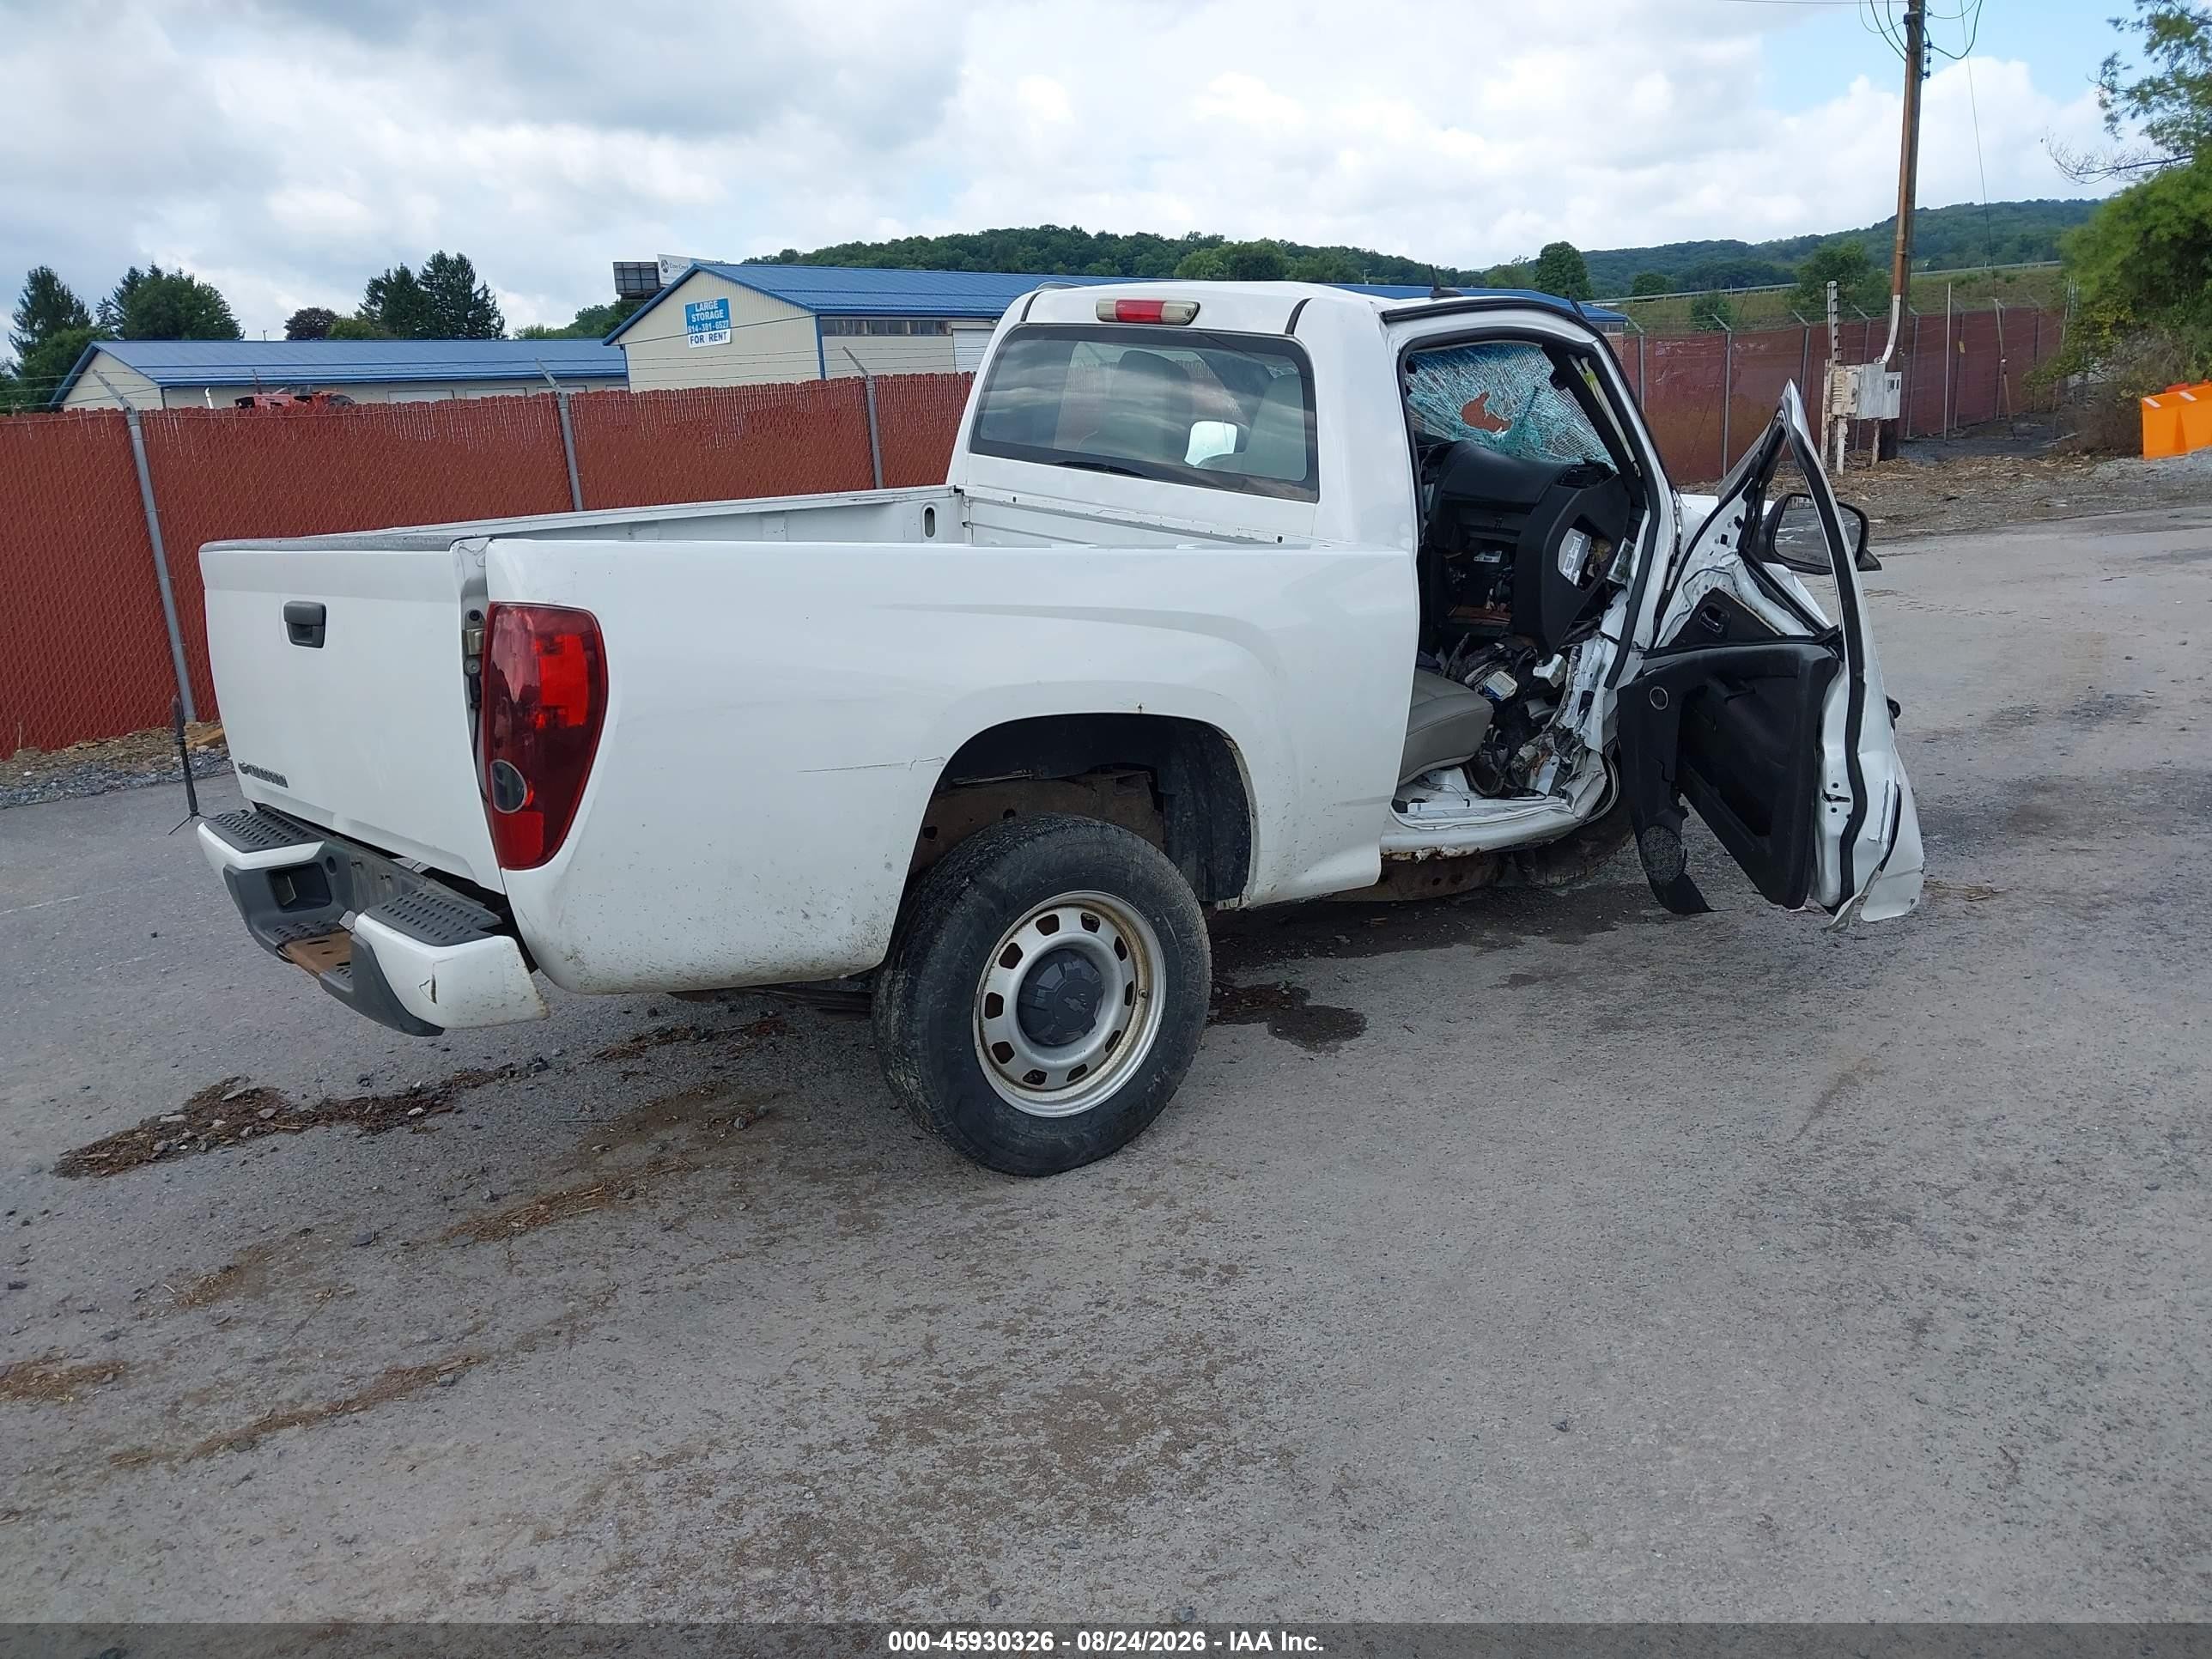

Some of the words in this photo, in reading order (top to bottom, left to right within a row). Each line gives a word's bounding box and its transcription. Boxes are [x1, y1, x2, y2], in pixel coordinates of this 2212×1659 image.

[695, 301, 719, 313] LARGE
[691, 309, 724, 323] STORAGE
[690, 334, 705, 345] FOR
[708, 331, 727, 343] RENT
